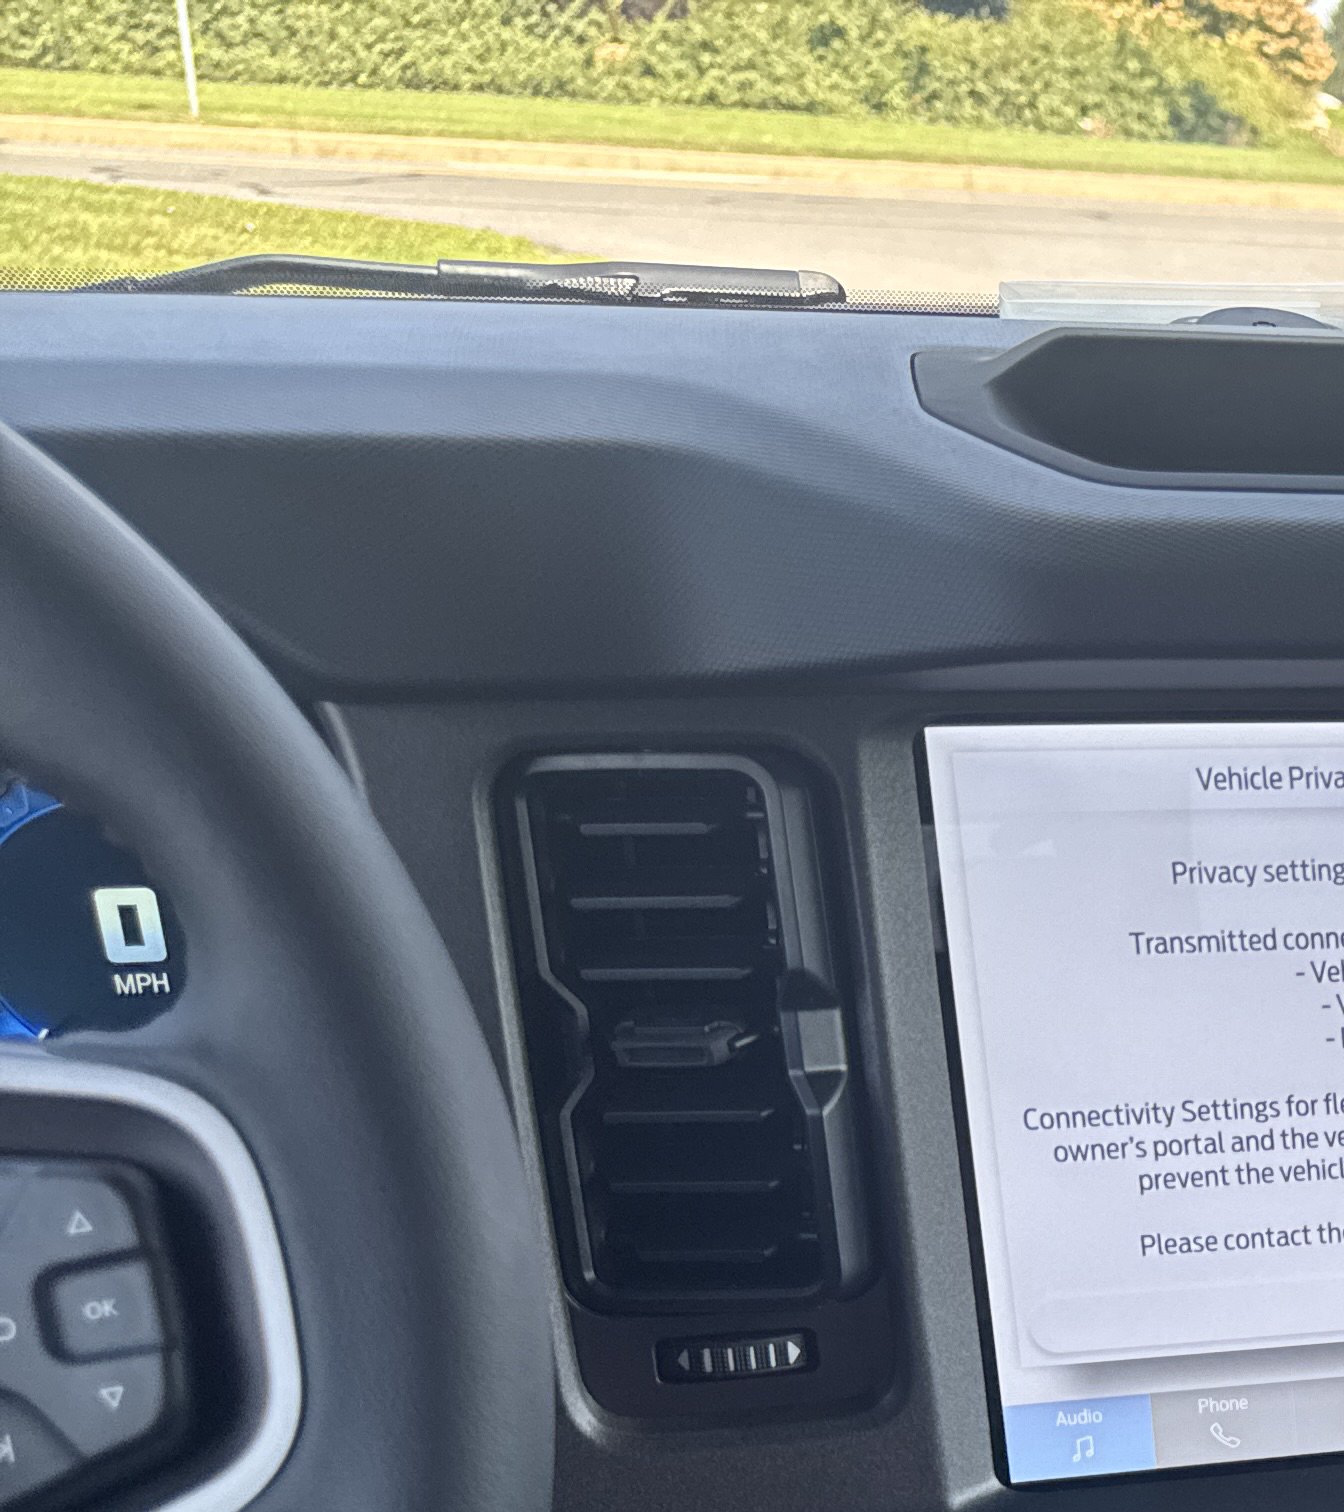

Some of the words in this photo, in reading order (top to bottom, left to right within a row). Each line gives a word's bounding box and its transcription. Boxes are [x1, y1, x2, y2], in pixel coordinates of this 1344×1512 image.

[1196, 766, 1283, 791] Vehicle
[1171, 861, 1257, 887] Privacy
[94, 887, 168, 963] 0
[1128, 927, 1277, 956] Transmitted
[113, 972, 171, 995] MPH
[1023, 1102, 1176, 1131] Connectivity
[1181, 1097, 1281, 1123] Settings
[1285, 1093, 1319, 1118] for
[1053, 1136, 1147, 1163] owner's
[1153, 1131, 1226, 1160] portal
[1231, 1128, 1275, 1153] and
[1279, 1126, 1319, 1150] the
[1139, 1164, 1229, 1195] prevent
[1234, 1162, 1275, 1185] the
[1140, 1230, 1219, 1257] Please
[1223, 1225, 1313, 1252] contact
[82, 1299, 118, 1320] OK
[1056, 1407, 1103, 1427] Audio
[1198, 1395, 1249, 1414] Phone
